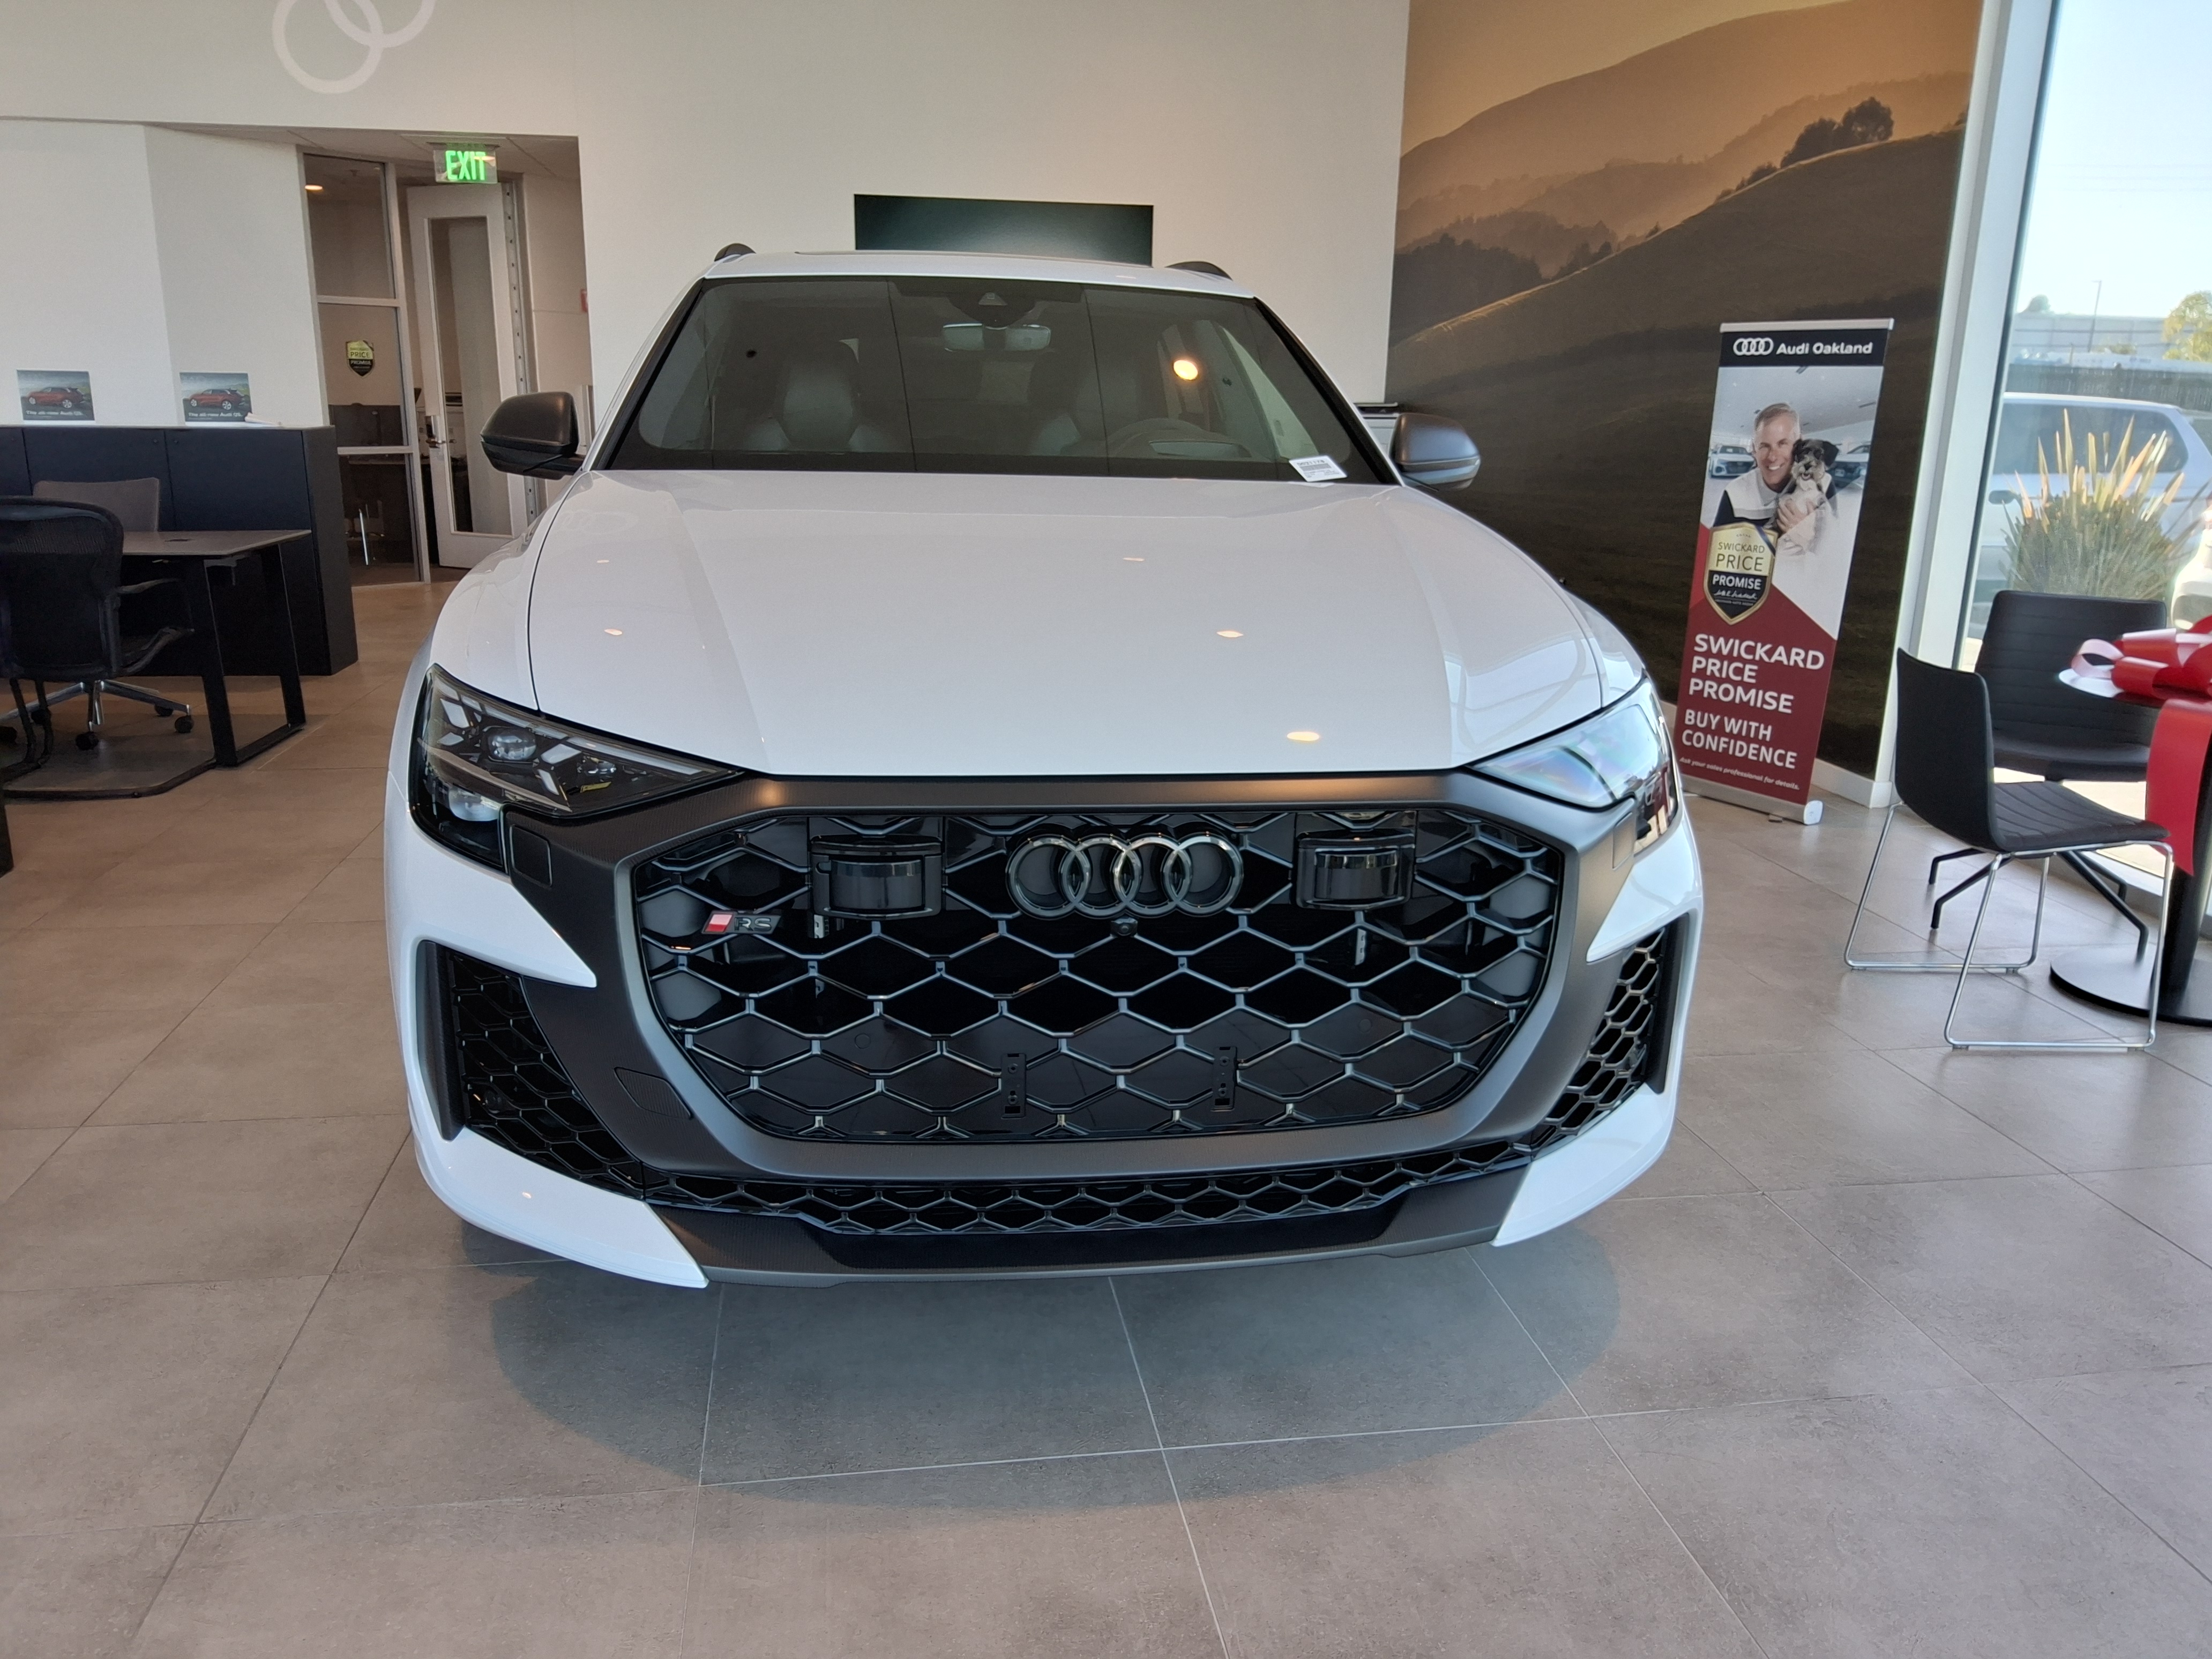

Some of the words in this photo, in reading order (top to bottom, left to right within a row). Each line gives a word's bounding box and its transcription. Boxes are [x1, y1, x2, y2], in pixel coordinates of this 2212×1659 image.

[445, 150, 486, 181] EXIT
[1775, 342, 1810, 355] Audi
[1812, 341, 1873, 355] Oakland
[1717, 541, 1765, 554] SWICKARD
[1716, 553, 1764, 572] PRICE
[1712, 574, 1762, 590] PROMISE
[1693, 633, 1825, 670] SWICKARD
[1691, 655, 1759, 684] PRICE
[1688, 677, 1795, 714] PROMISE
[1684, 708, 1721, 730] BUY
[1723, 716, 1773, 742] WITH
[1682, 729, 1798, 769] CONFIDENCE
[1706, 764, 1723, 772] sales
[1722, 768, 1764, 782] professional
[1763, 775, 1775, 784] for
[1775, 779, 1800, 790] details.
[734, 917, 772, 931] RS
